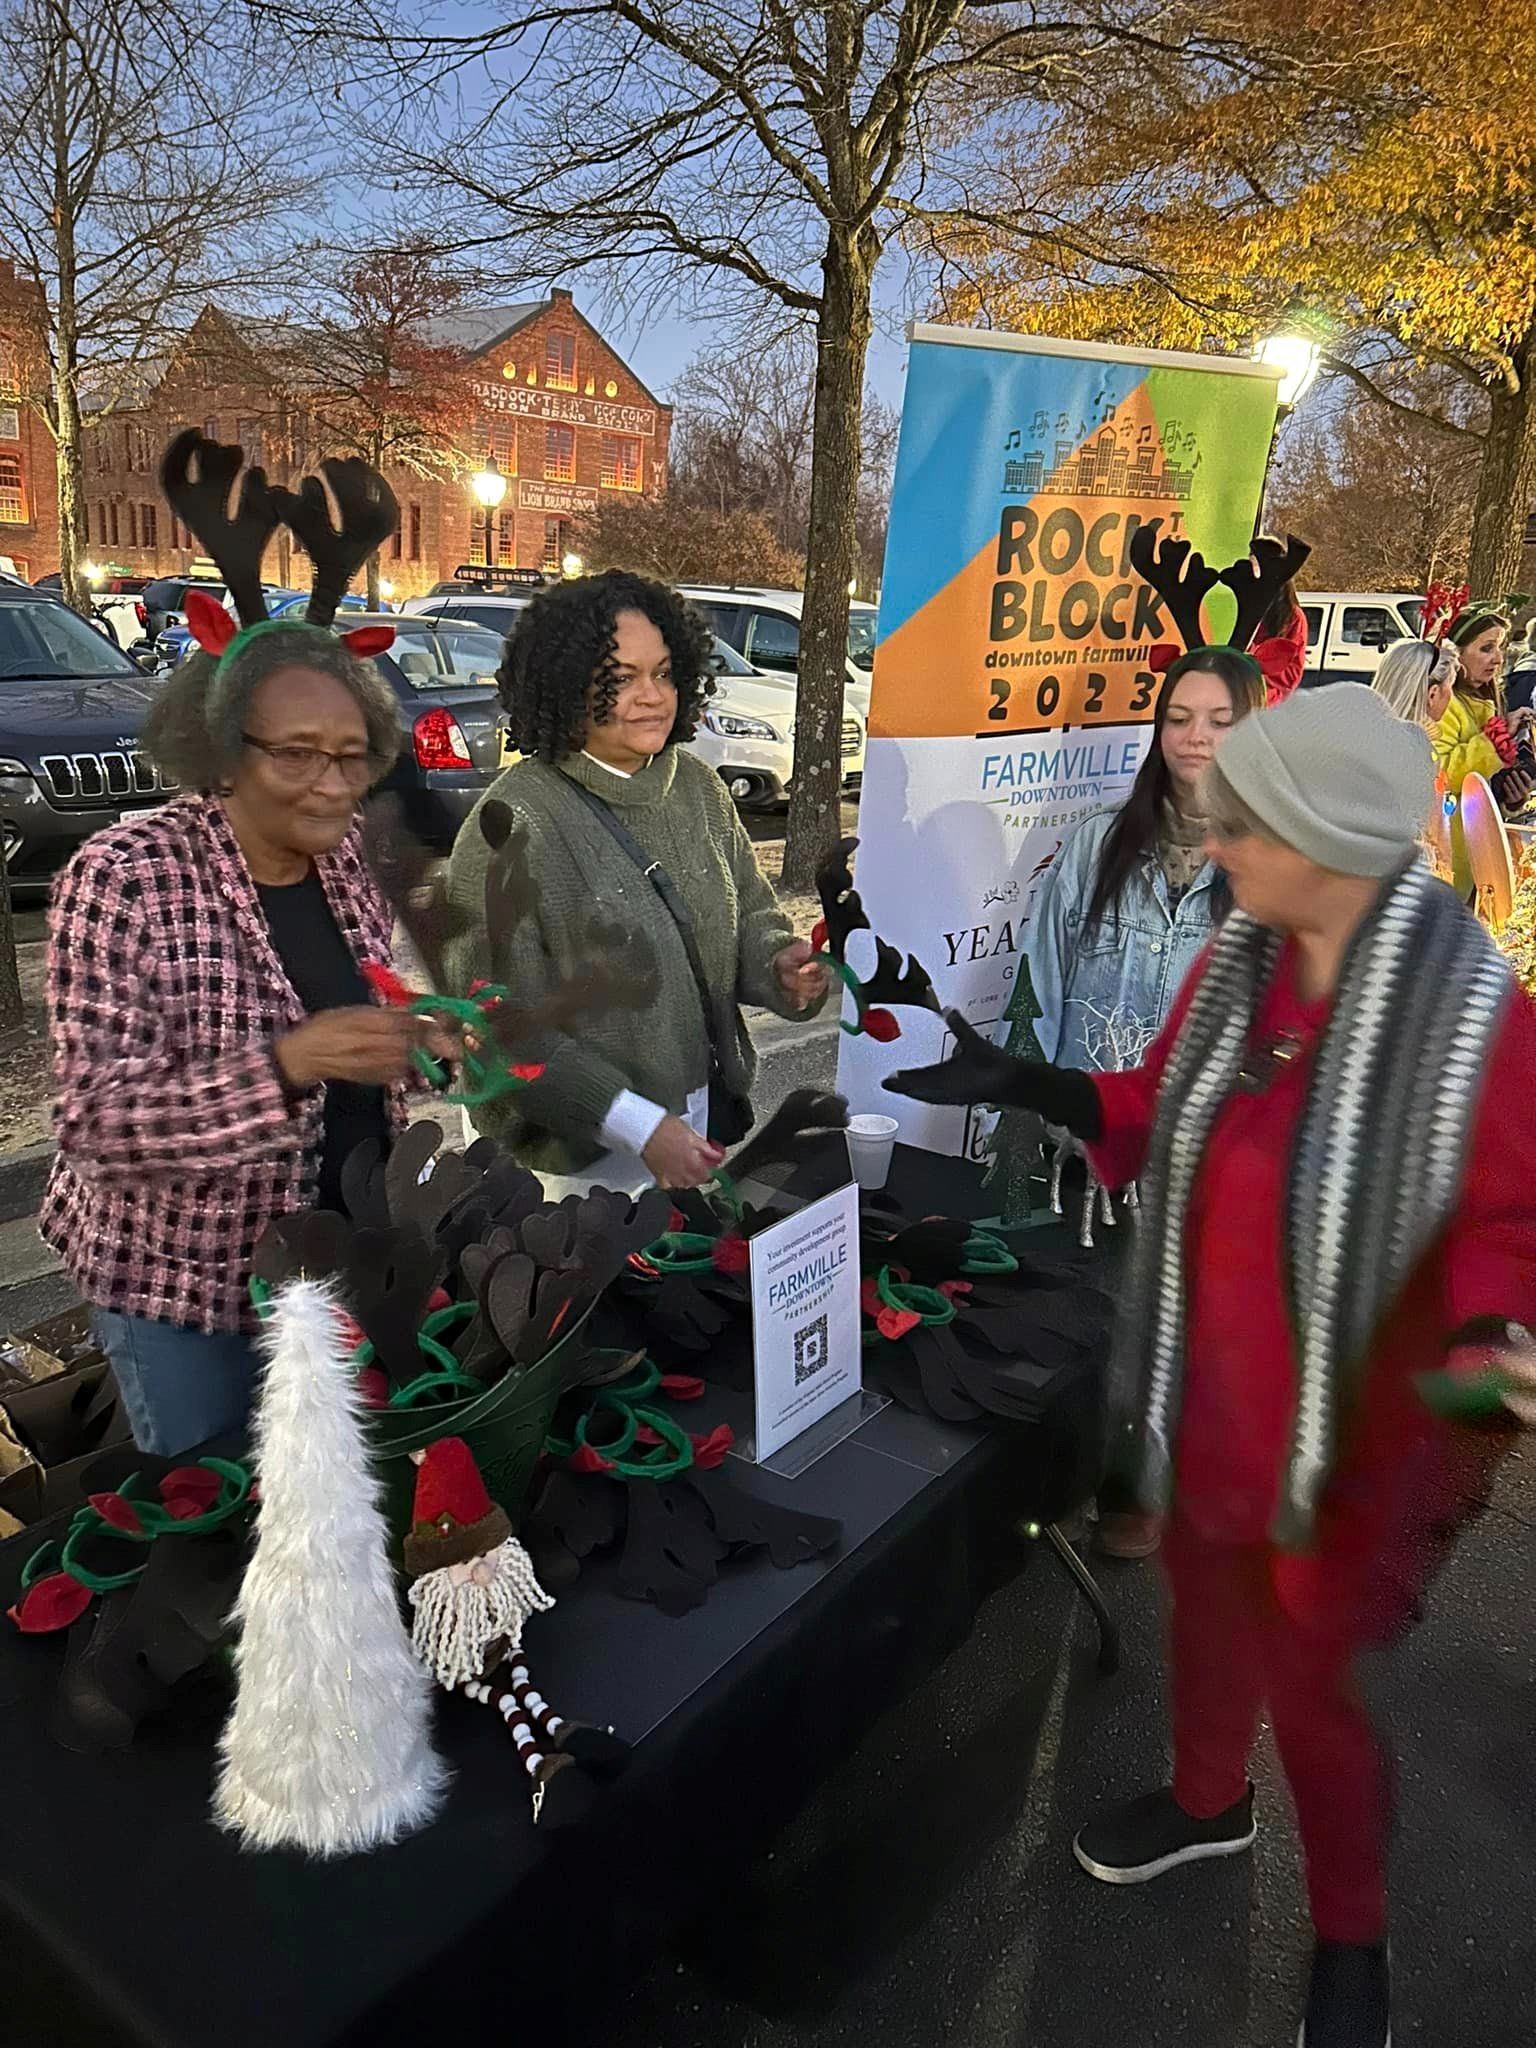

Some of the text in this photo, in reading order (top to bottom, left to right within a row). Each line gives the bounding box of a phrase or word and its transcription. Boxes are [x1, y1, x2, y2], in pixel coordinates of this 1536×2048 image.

[541, 407, 586, 422] BRAND
[989, 579, 1165, 642] BLOCK
[985, 645, 1149, 668] downtown farmvil
[981, 742, 1140, 790] FARMVILLE
[1009, 782, 1103, 807] DOWNTOWN
[942, 918, 1030, 967] YEA
[769, 1243, 847, 1307] FARMVILLE
[785, 1273, 833, 1308] DOWNTOWN
[784, 1284, 835, 1320] PARTNERSHIP
